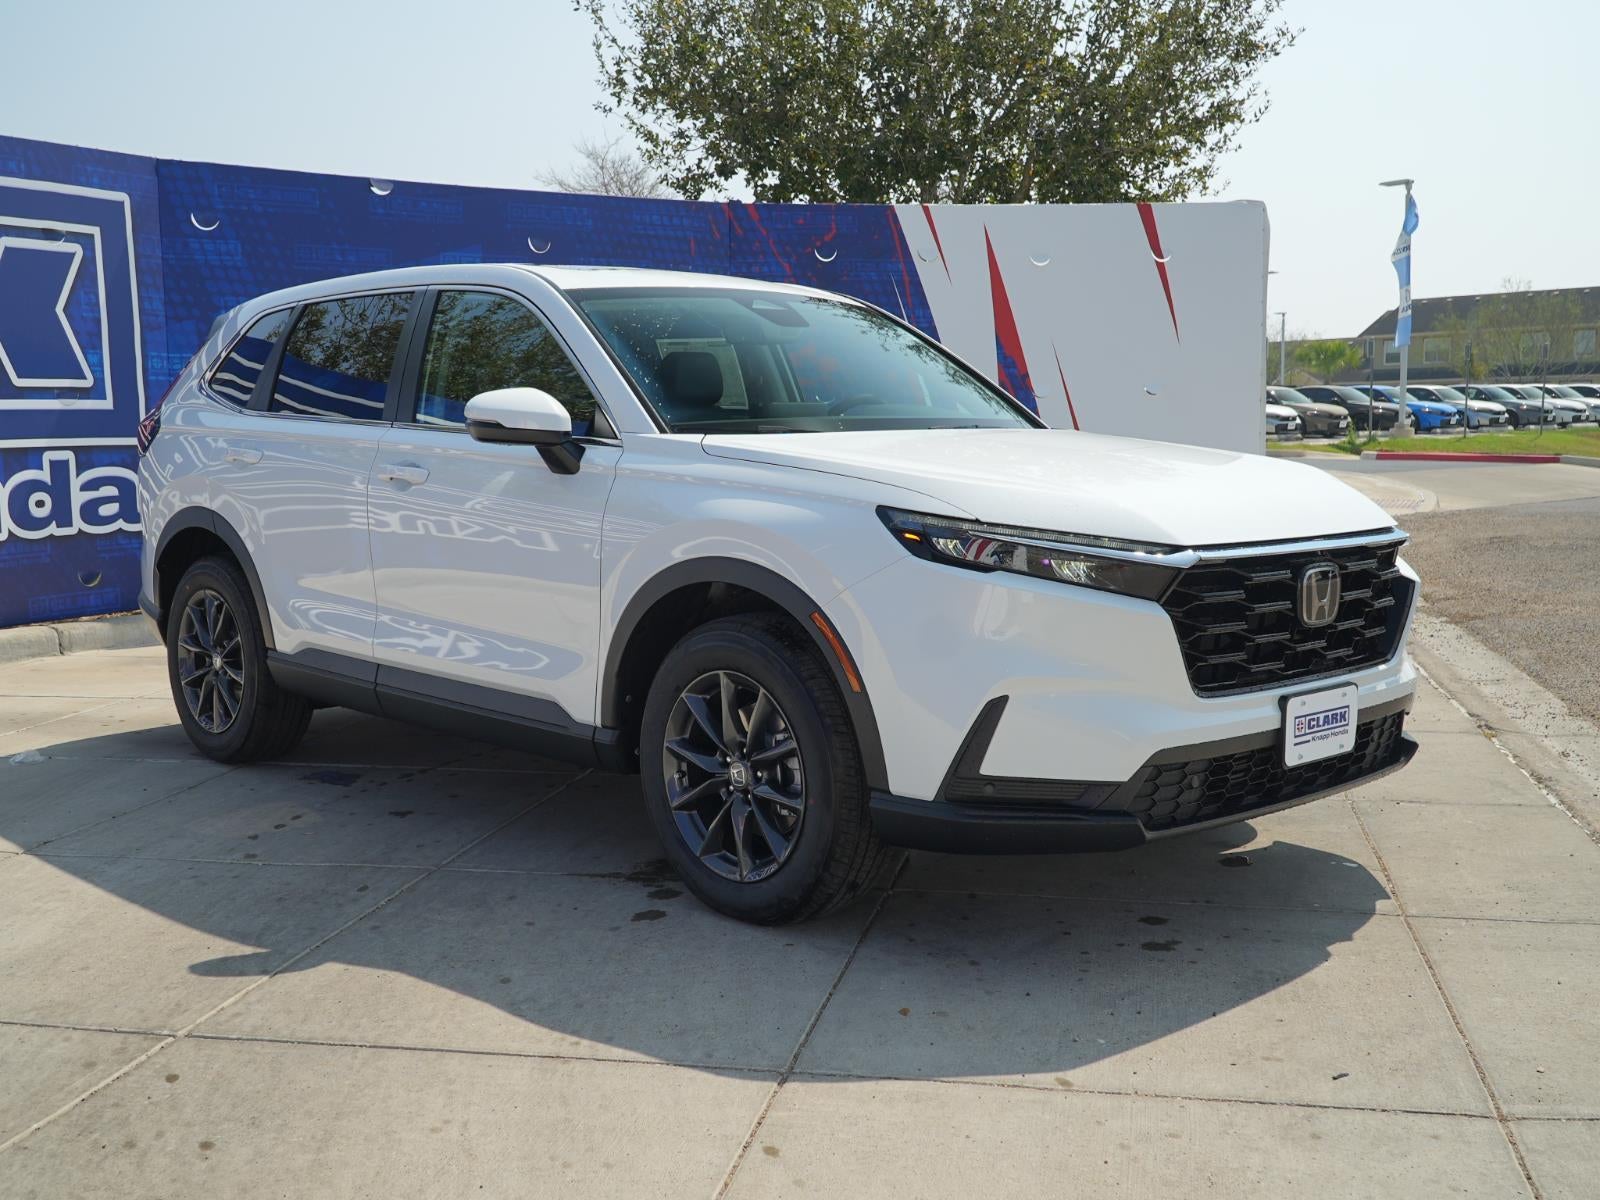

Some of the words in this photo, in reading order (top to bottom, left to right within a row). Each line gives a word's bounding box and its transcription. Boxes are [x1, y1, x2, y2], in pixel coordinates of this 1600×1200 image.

[0, 450, 142, 541] da
[1307, 710, 1347, 730] CLARK
[1311, 733, 1330, 742] Knapp
[1330, 728, 1349, 738] Honda
